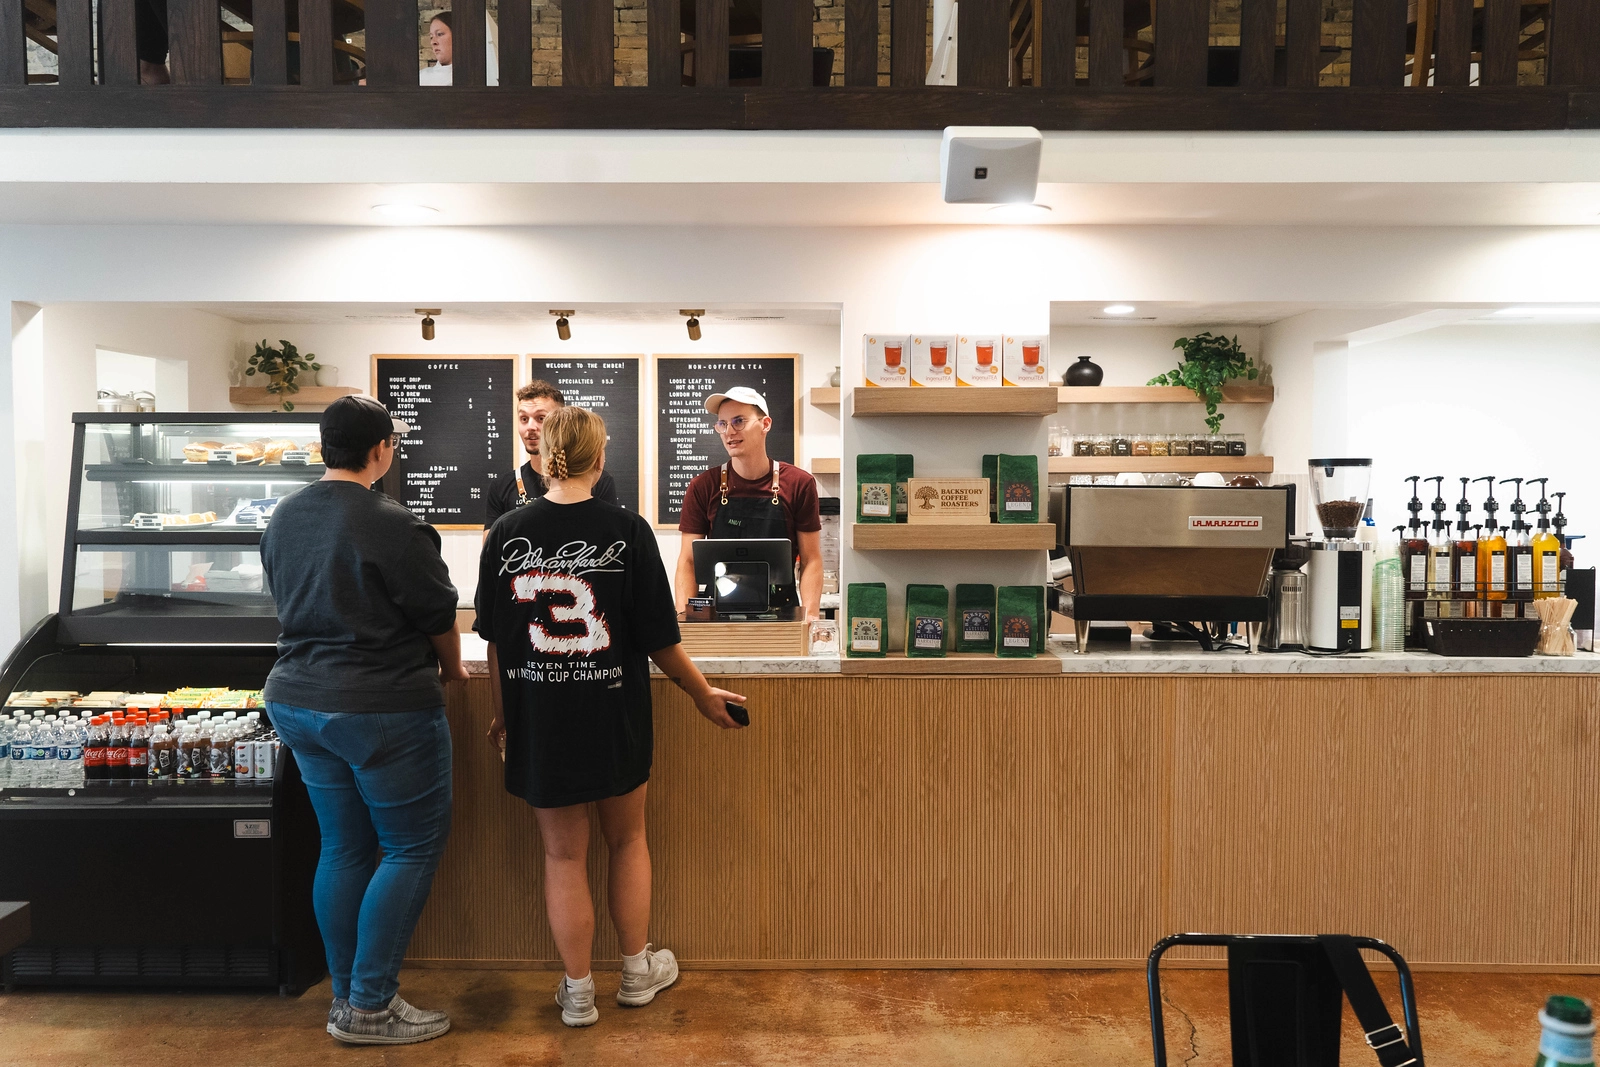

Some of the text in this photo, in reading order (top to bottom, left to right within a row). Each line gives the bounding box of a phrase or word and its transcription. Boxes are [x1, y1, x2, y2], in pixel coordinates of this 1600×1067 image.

[510, 569, 611, 657] 3
[854, 620, 879, 636] BACKSTORY
[916, 619, 942, 634] BACKSTORY
[1004, 617, 1030, 633] BACKSTORY
[527, 661, 562, 669] SEVEN
[507, 666, 623, 682] WINSTON CUP CHAMPION
